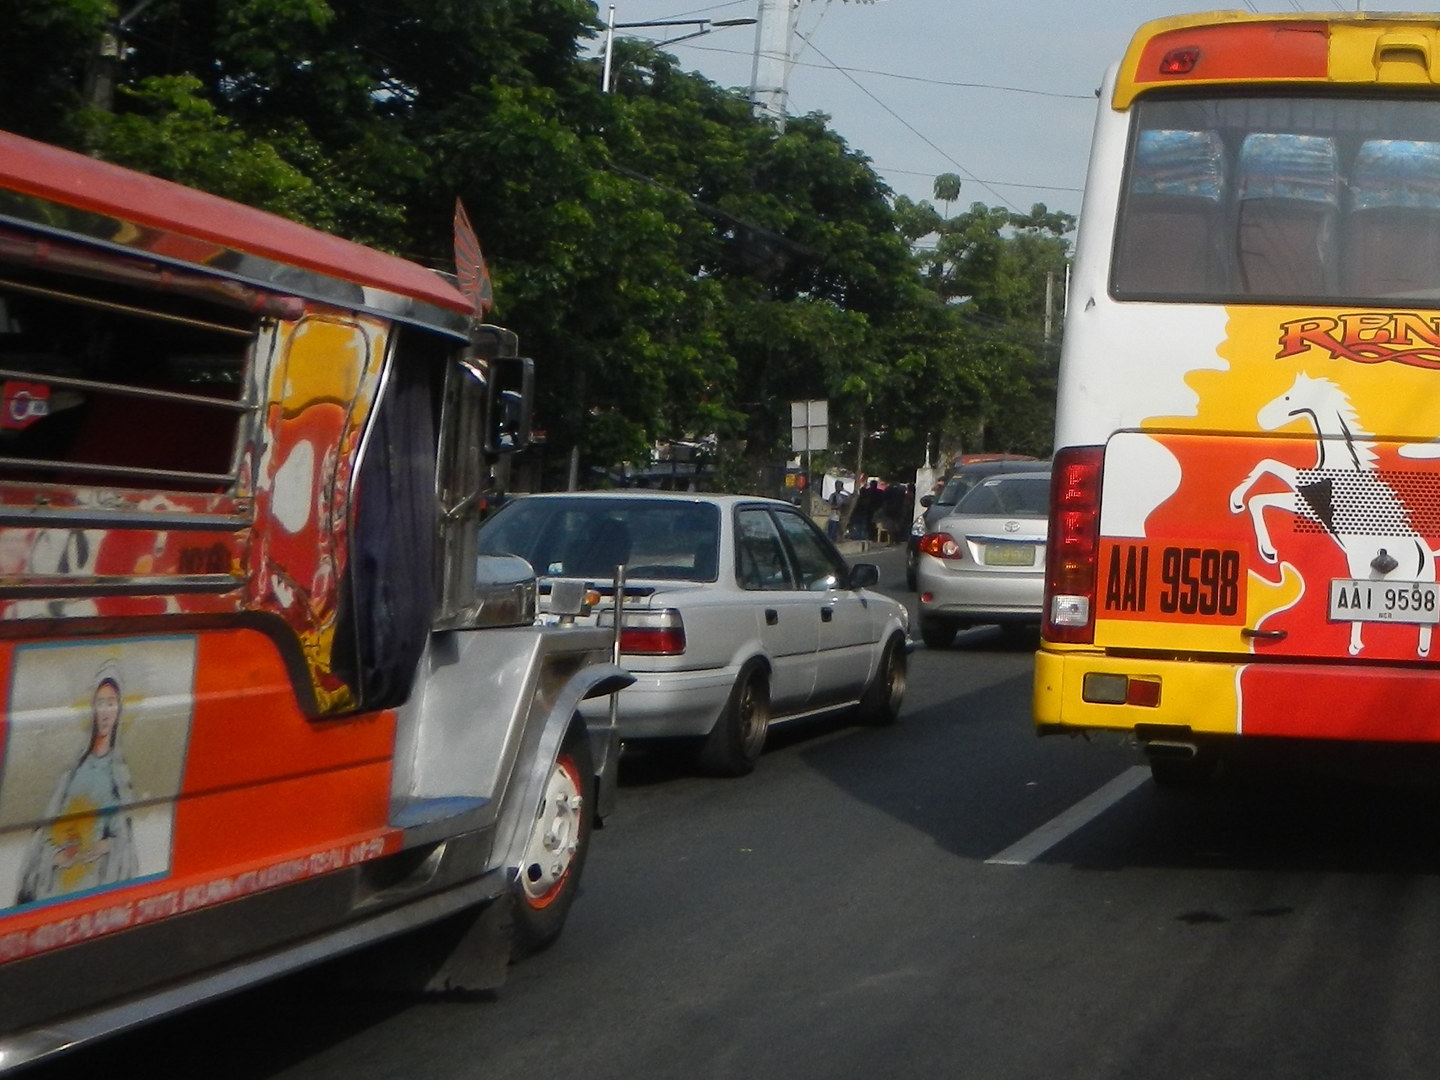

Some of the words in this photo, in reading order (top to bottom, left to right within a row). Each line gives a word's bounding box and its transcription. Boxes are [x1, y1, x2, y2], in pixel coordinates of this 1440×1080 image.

[1105, 544, 1149, 612] AAI
[1160, 546, 1240, 616] 9598
[1337, 587, 1372, 610] AAI
[1384, 588, 1435, 612] 9598
